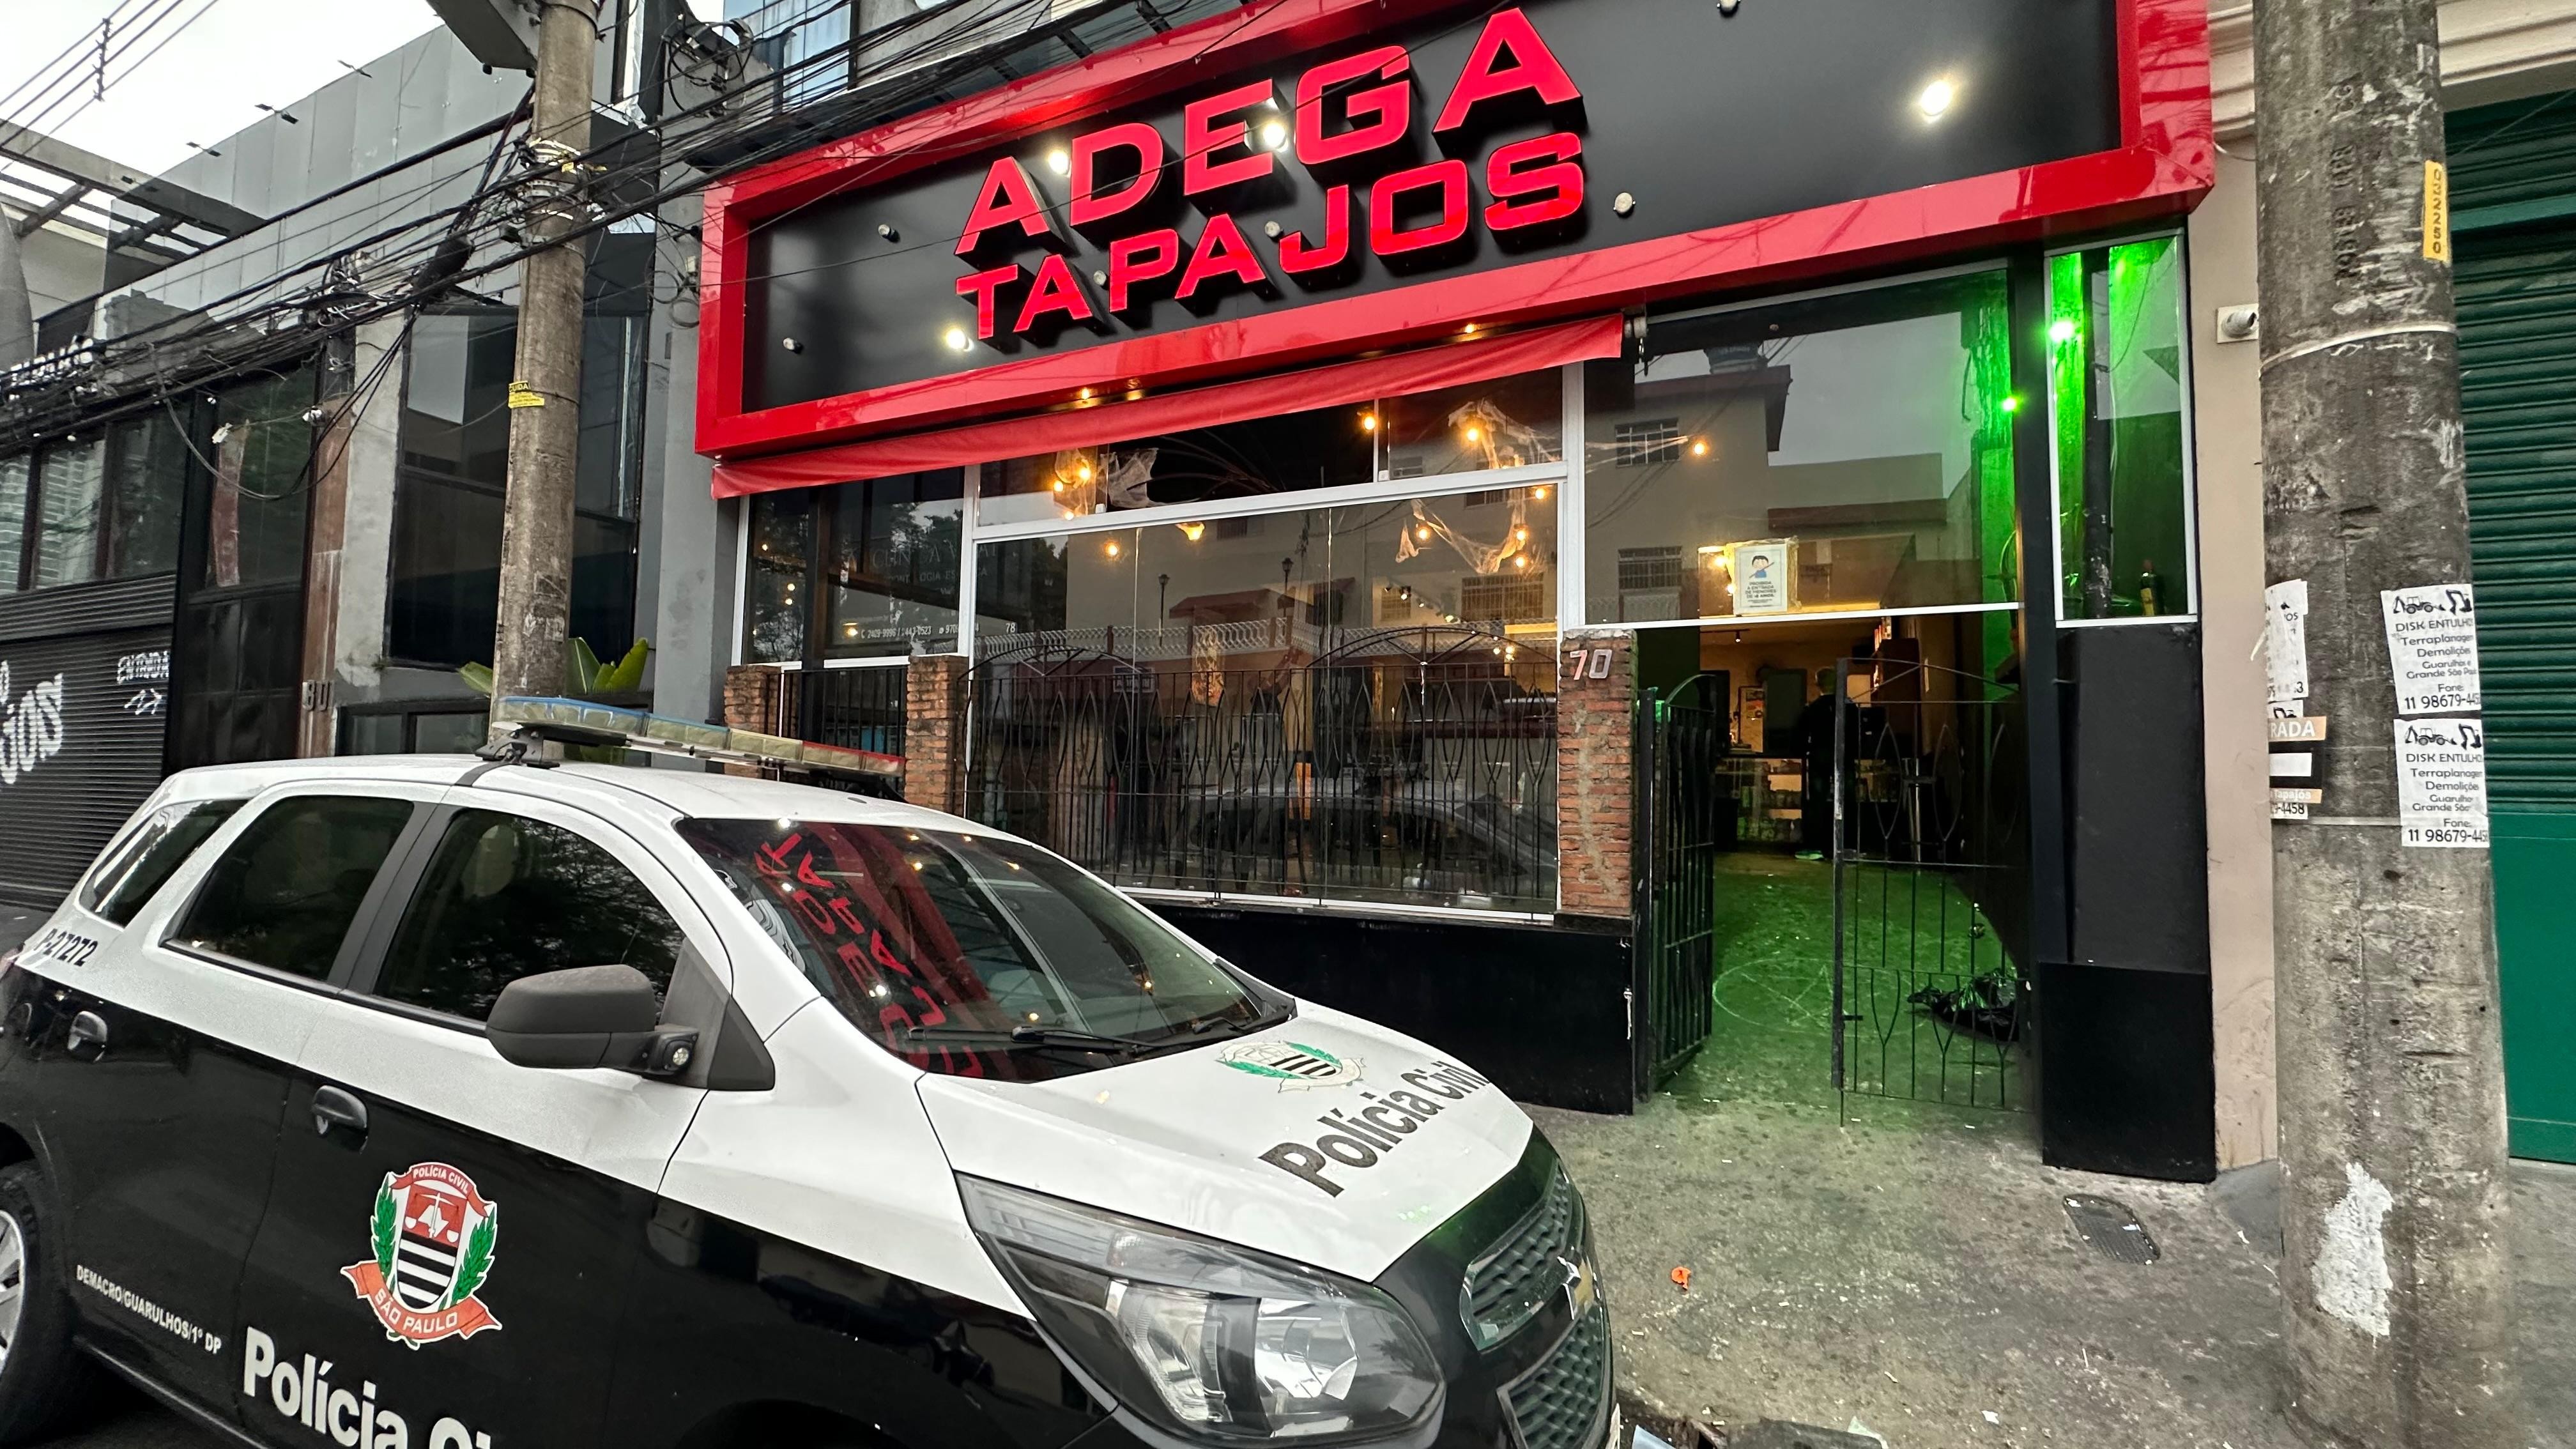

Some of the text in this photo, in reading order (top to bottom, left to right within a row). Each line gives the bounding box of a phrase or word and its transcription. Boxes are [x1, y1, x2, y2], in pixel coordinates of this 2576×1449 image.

[955, 6, 1581, 256] ADEGA
[955, 132, 1583, 340] TAPAJOS
[1006, 622, 1016, 634] 78
[2396, 621, 2425, 632] DISK
[1570, 648, 1613, 680] 70
[2406, 670, 2445, 678] Grande
[2404, 696, 2416, 709] 11
[2406, 753, 2435, 762] DISK
[2409, 829, 2419, 841] 11
[1258, 1061, 1490, 1198] Polícia Civil
[413, 1165, 469, 1194] POLÍCIA CIVIL
[374, 1287, 458, 1333] SÃO PAULO
[204, 1332, 222, 1354] DP
[243, 1326, 408, 1449] Polícia
